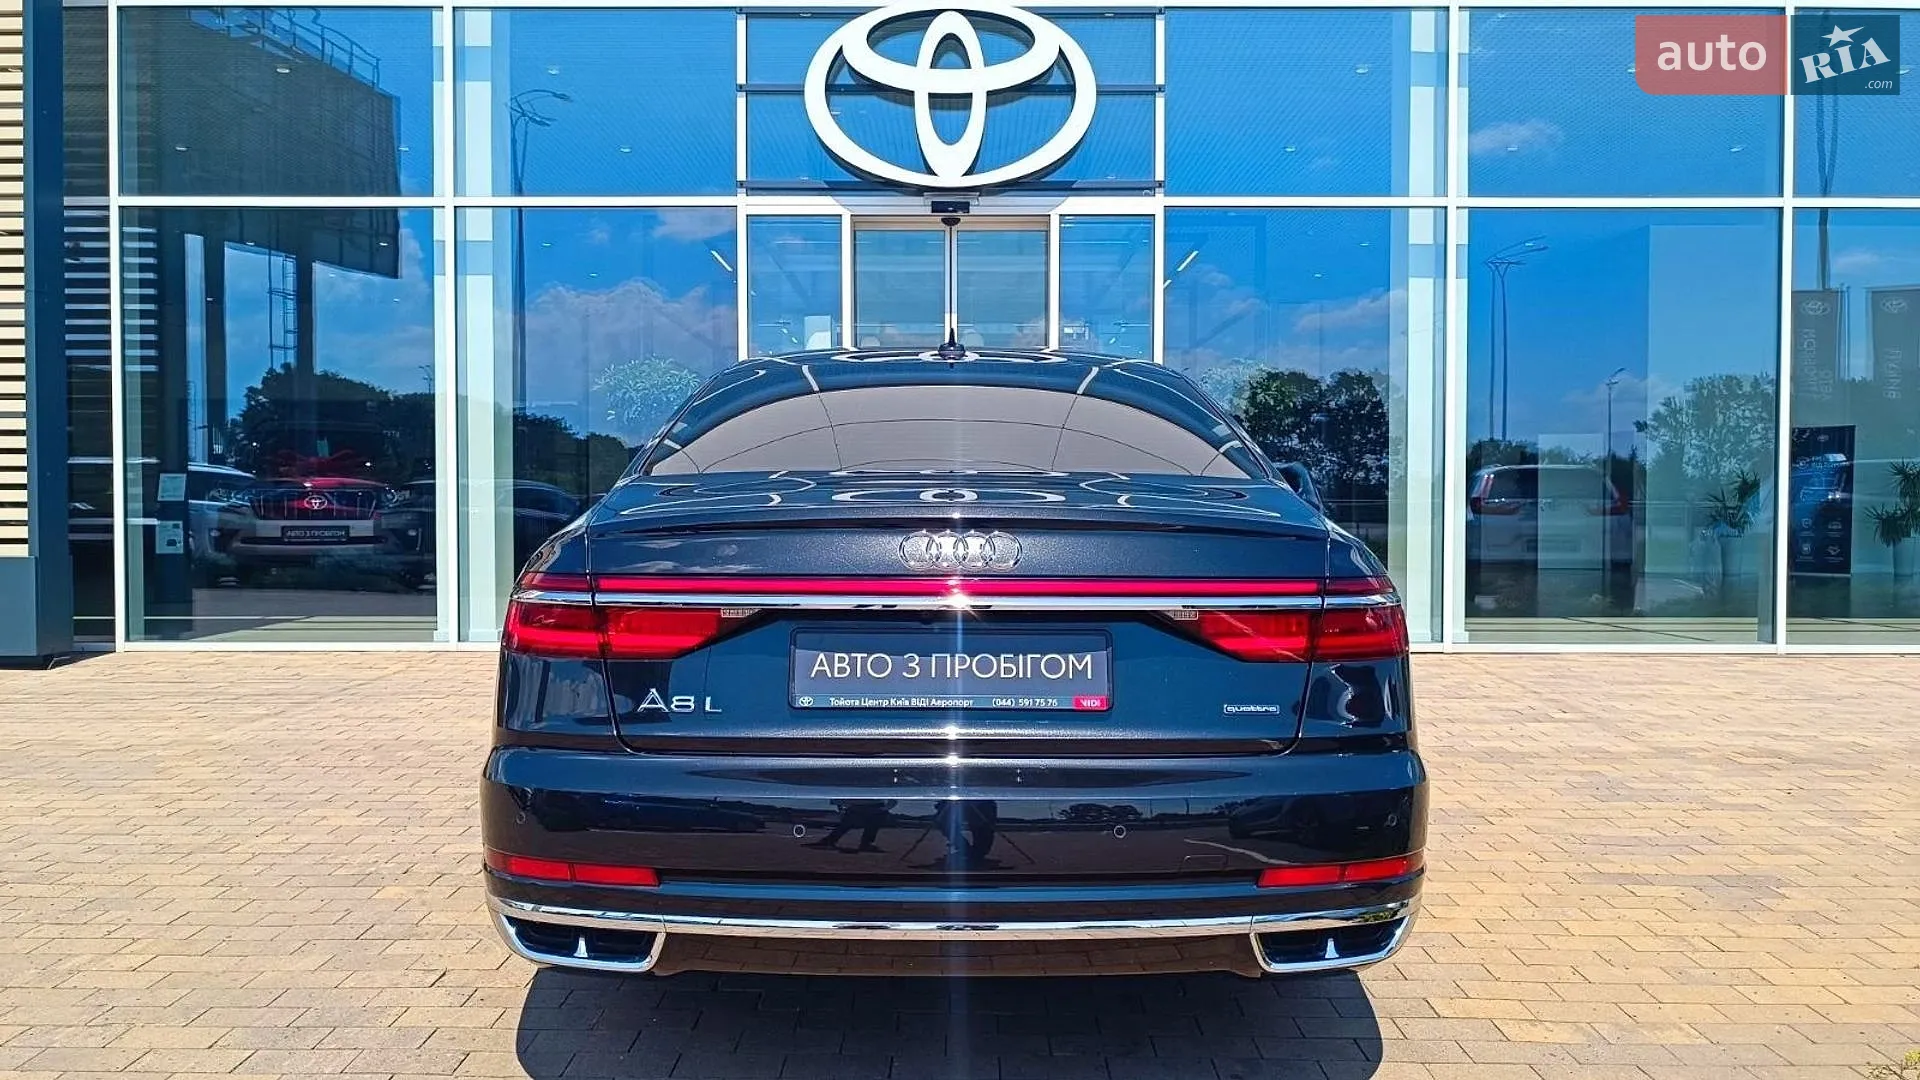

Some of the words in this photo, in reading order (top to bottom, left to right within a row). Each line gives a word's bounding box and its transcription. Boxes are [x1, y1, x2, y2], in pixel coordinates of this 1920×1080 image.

[810, 652, 892, 679] АВТО
[902, 652, 921, 679] З
[931, 652, 1092, 680] ПРОБІГОМ
[704, 696, 723, 713] L
[829, 696, 860, 706] Тойота
[861, 696, 889, 708] Центр
[890, 697, 909, 706] Київ
[911, 697, 929, 708] ВІДІ
[930, 697, 974, 708] Аеропорт
[992, 697, 1016, 707] (044)
[1018, 698, 1033, 707] 591
[1034, 698, 1046, 707] 75
[1046, 698, 1058, 707] 76
[1081, 698, 1101, 707] VIDI
[1226, 704, 1278, 713] quattro
